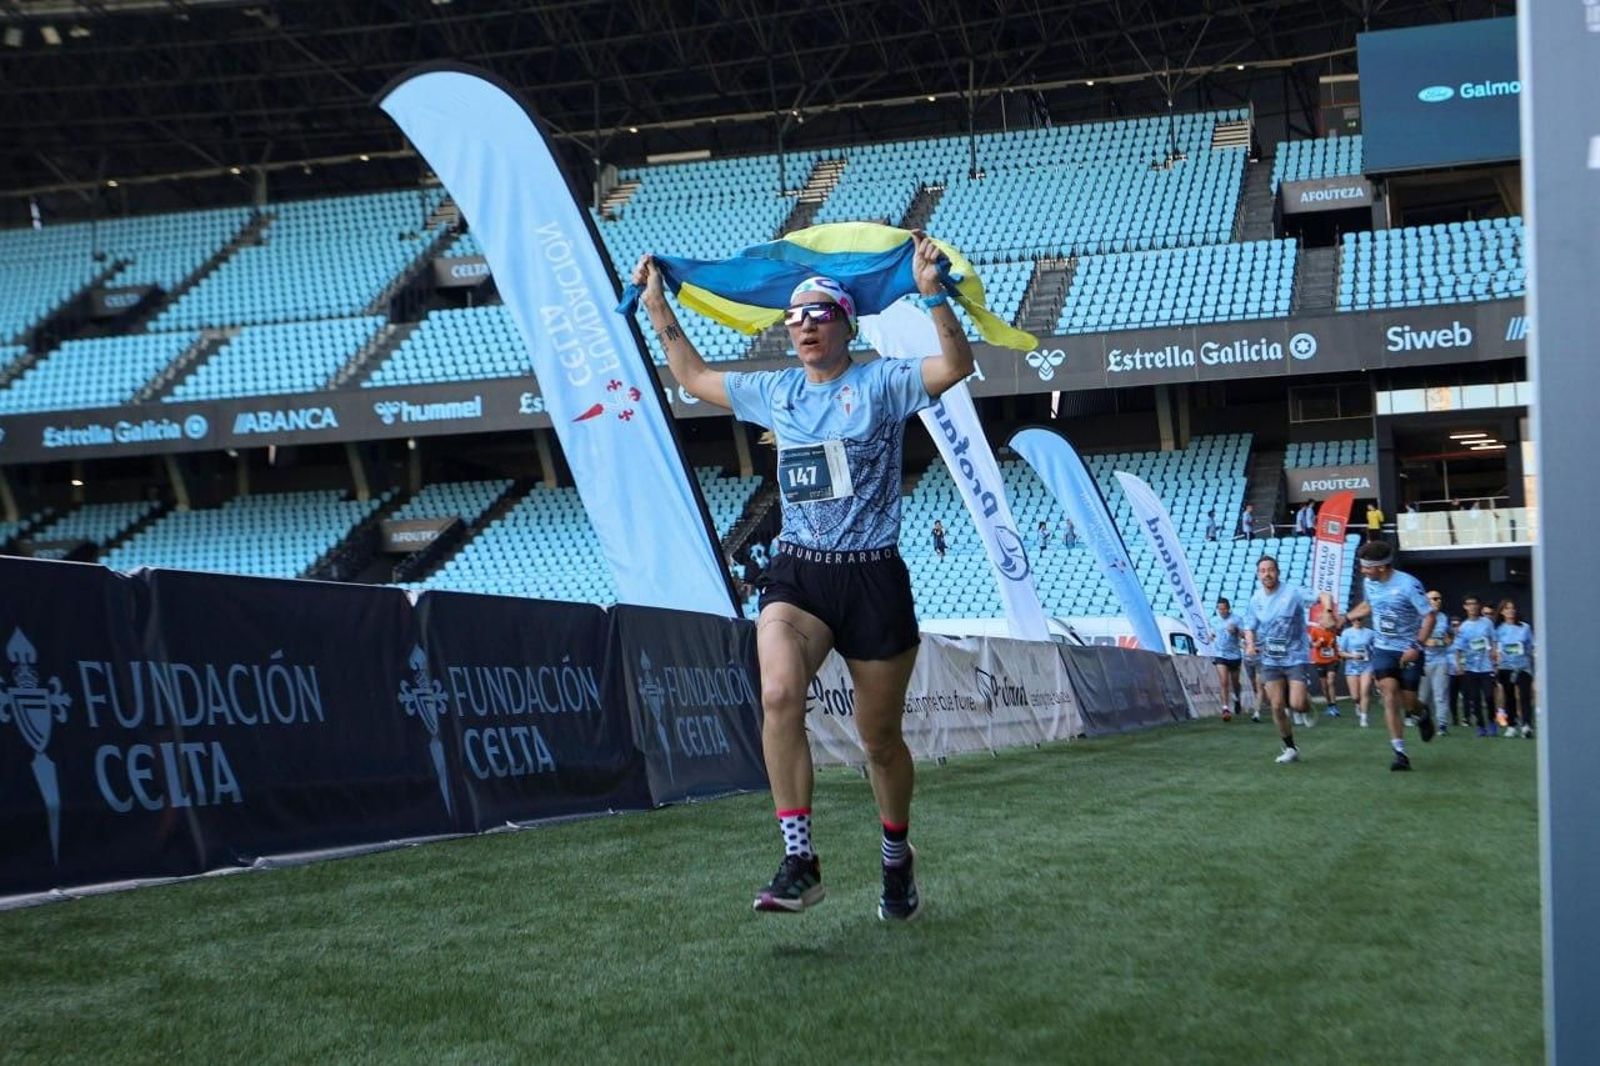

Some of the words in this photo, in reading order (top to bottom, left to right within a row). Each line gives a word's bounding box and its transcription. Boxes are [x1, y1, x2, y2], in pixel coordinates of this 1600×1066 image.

[1460, 80, 1521, 98] Galmo
[1386, 321, 1472, 351] Siweb
[1106, 346, 1195, 372] Estrella
[1200, 338, 1283, 366] Galicia
[234, 407, 338, 433] ABANCA
[401, 395, 481, 422] hummel
[788, 466, 817, 487] 147
[1301, 478, 1370, 492] AFOUTEZA
[78, 650, 325, 728] FUNDACIÓN
[448, 655, 601, 716] FUNDACIÓN
[663, 660, 756, 707] FUNDACIÓN
[464, 726, 556, 779] CELTA
[676, 716, 730, 758] CELTA
[95, 742, 243, 812] CELTA
